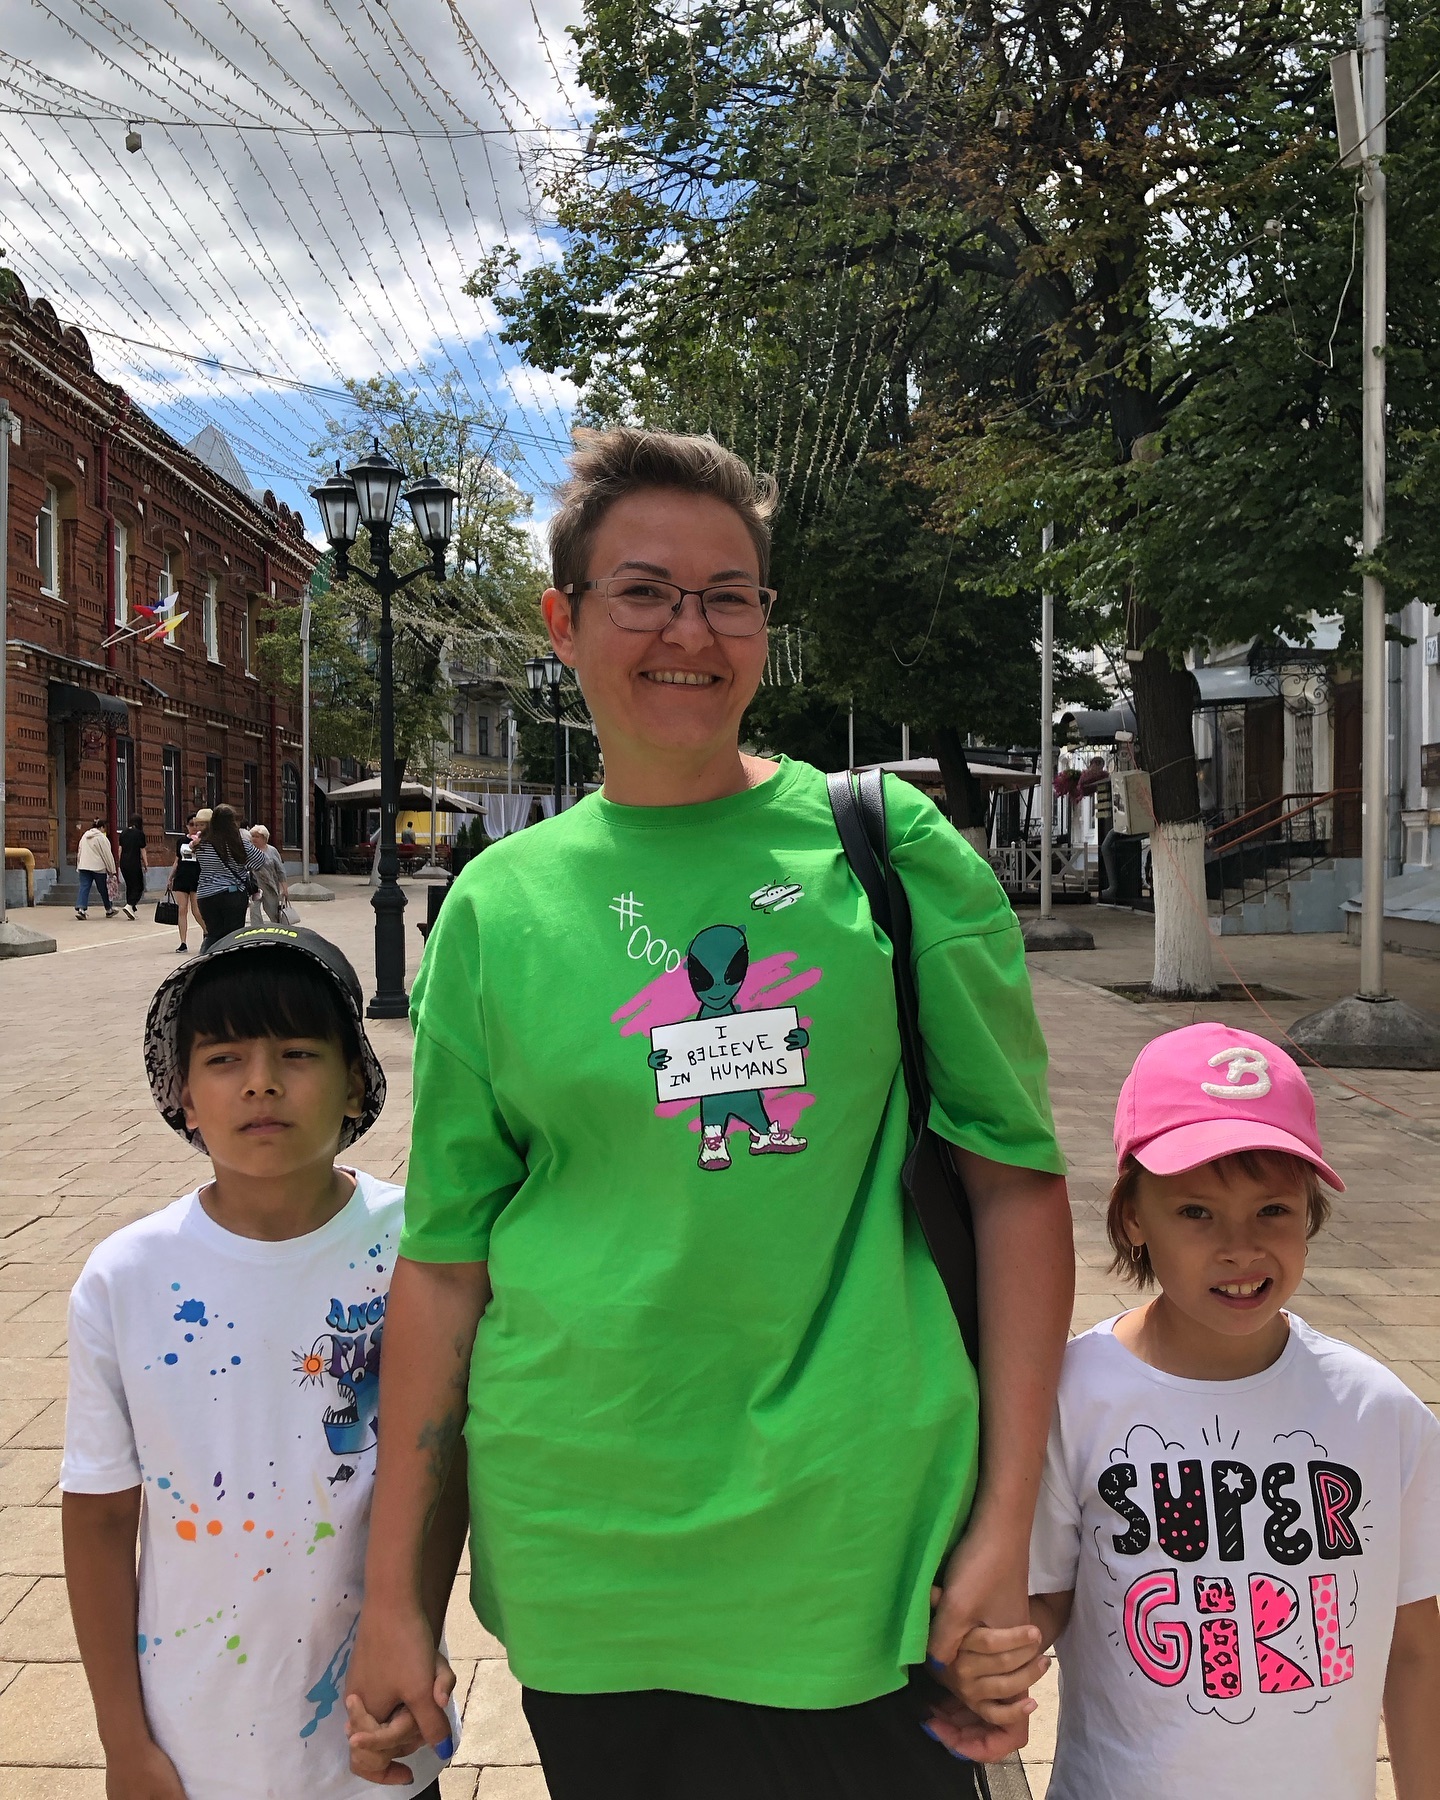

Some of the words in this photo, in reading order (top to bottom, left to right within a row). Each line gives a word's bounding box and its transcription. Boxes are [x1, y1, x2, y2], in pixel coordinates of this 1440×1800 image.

[714, 1025, 728, 1039] I
[669, 1072, 691, 1087] IN
[710, 1058, 788, 1081] HUMANS
[1201, 1047, 1272, 1099] B
[325, 1292, 389, 1333] ANG
[1098, 1459, 1363, 1565] SUPER
